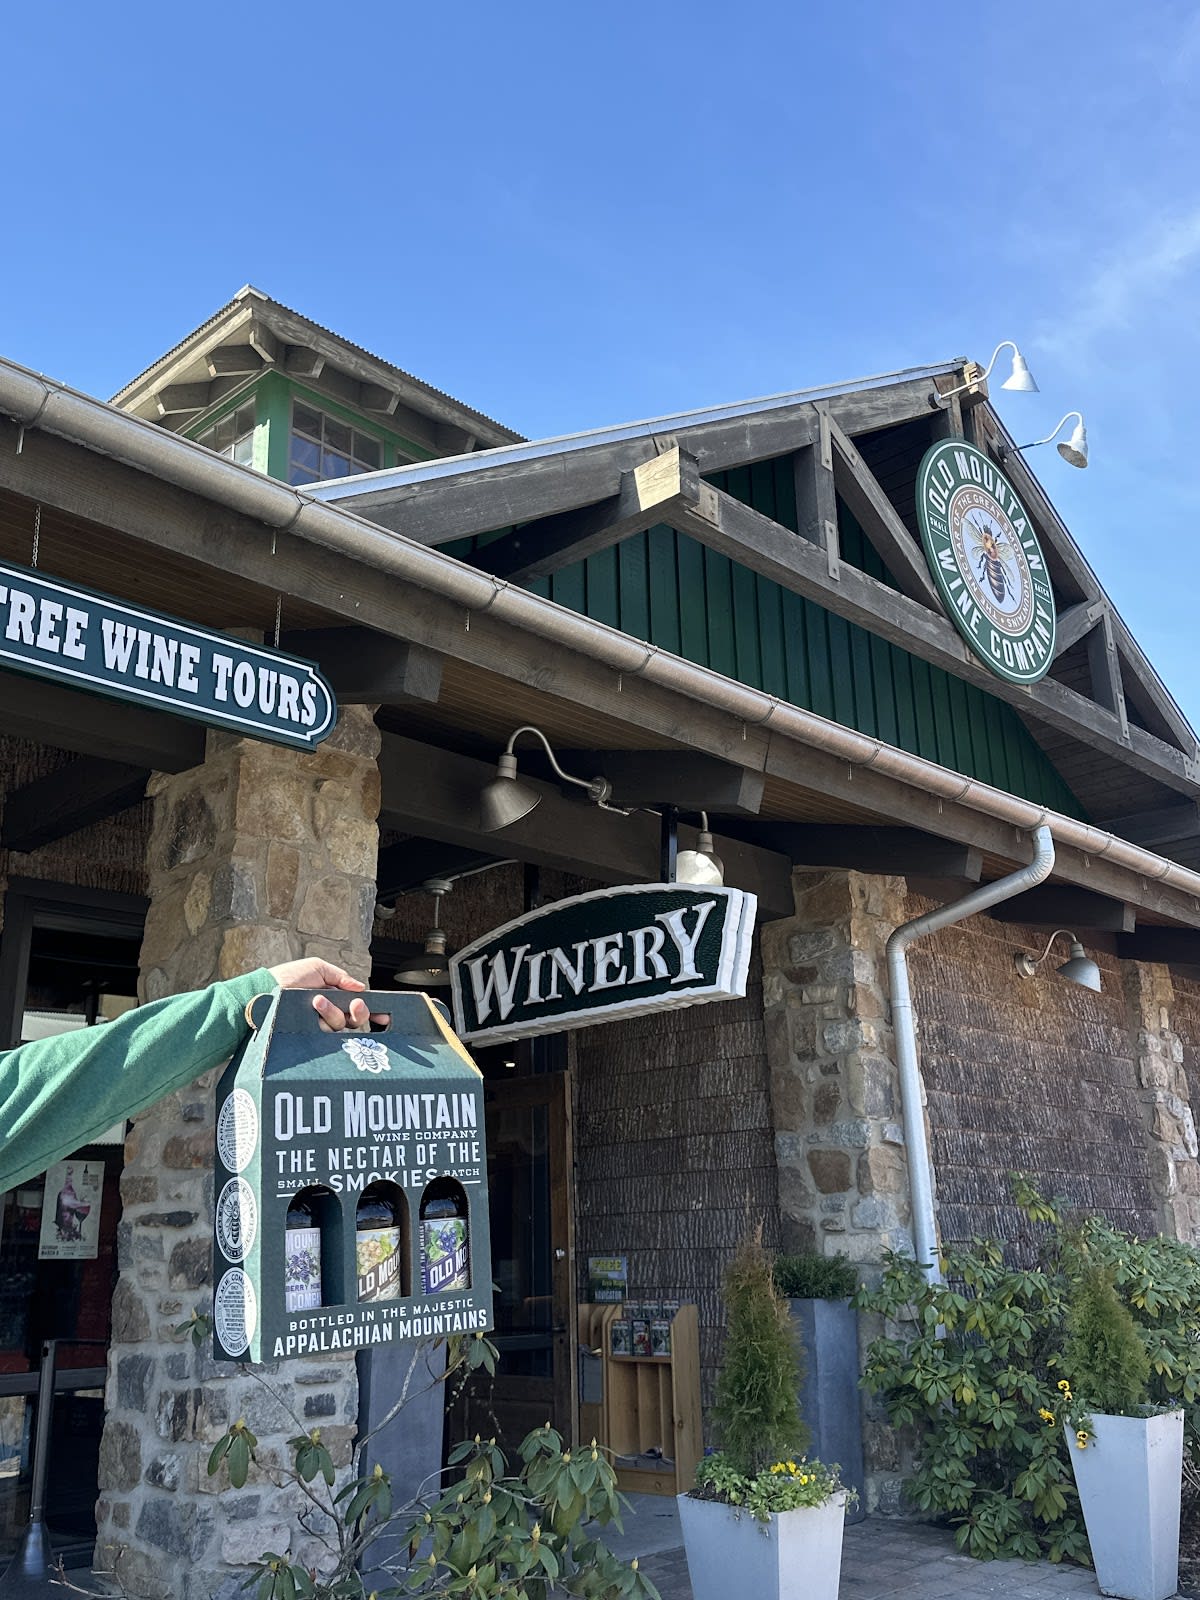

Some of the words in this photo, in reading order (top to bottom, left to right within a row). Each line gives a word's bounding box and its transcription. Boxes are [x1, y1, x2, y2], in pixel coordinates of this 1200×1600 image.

[928, 459, 955, 514] OLD
[953, 451, 1043, 570] MOUNTAIN
[954, 510, 961, 526] OF
[958, 495, 972, 509] THE
[973, 494, 1000, 518] GREAT
[1003, 523, 1024, 571] SMOKY
[938, 548, 982, 634] WINE
[990, 601, 1051, 670] COMPANY
[980, 599, 998, 618] THE
[0, 586, 88, 661] REE
[102, 618, 200, 694] WINE
[212, 653, 317, 726] TOURS
[463, 900, 716, 1024] WINERY
[275, 1092, 332, 1141] OLD
[343, 1091, 477, 1138] MOUNTAIN
[373, 1133, 410, 1142] WINE
[415, 1130, 478, 1141] COMPANY
[276, 1149, 316, 1173] THE
[328, 1144, 406, 1171] NECTAR
[416, 1143, 437, 1166] OF
[447, 1142, 480, 1164] THE
[429, 1258, 453, 1289] OLD
[290, 1313, 354, 1331] BOTTLED
[361, 1310, 375, 1321] IN
[382, 1306, 407, 1319] THE
[413, 1298, 473, 1315] MAJESTIC
[273, 1322, 393, 1357] APPALACHIAN
[400, 1309, 487, 1339] MOUNTAINS
